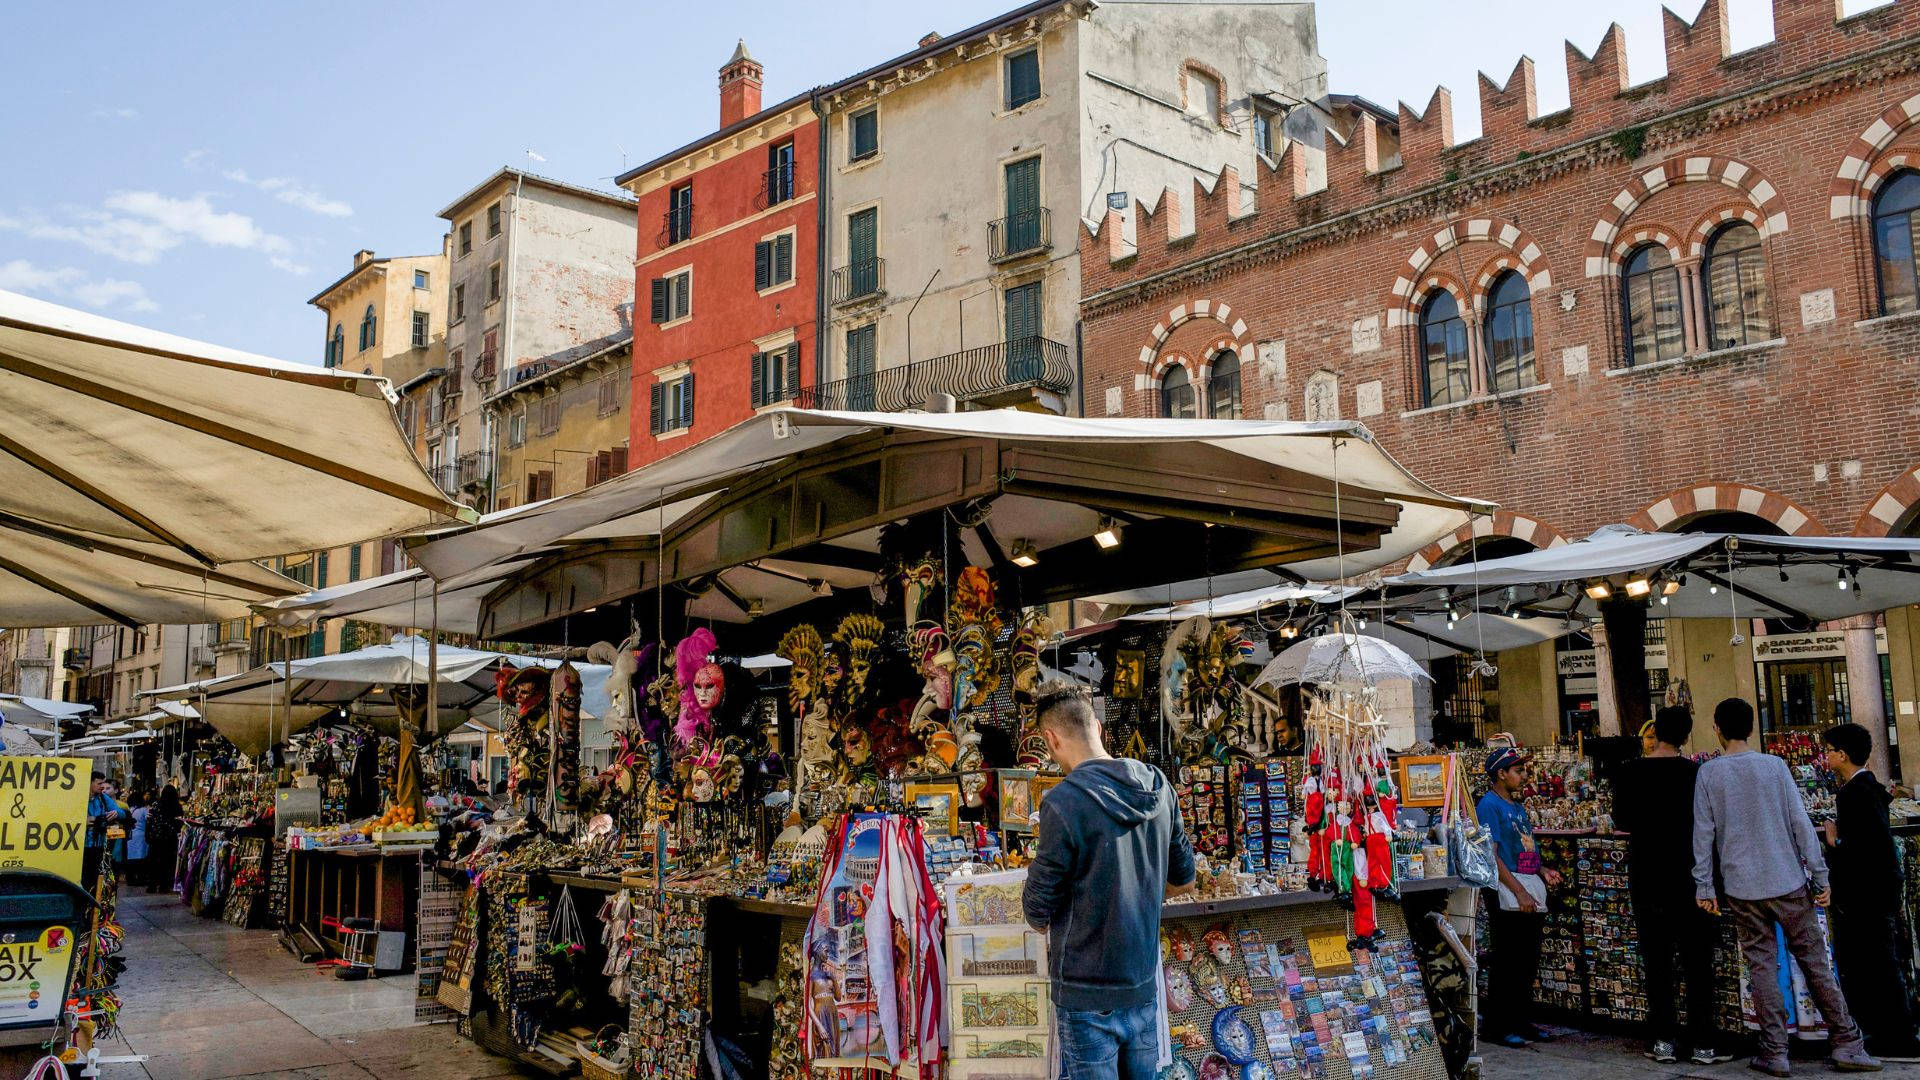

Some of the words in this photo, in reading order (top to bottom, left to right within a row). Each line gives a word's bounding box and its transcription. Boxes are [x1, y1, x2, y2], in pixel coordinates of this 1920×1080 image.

[1769, 638, 1814, 647] BANCA
[1786, 643, 1839, 653] VERONA
[0, 760, 76, 791] AMPS
[10, 793, 26, 818] &
[24, 822, 82, 851] BOX
[2, 860, 24, 868] GPS
